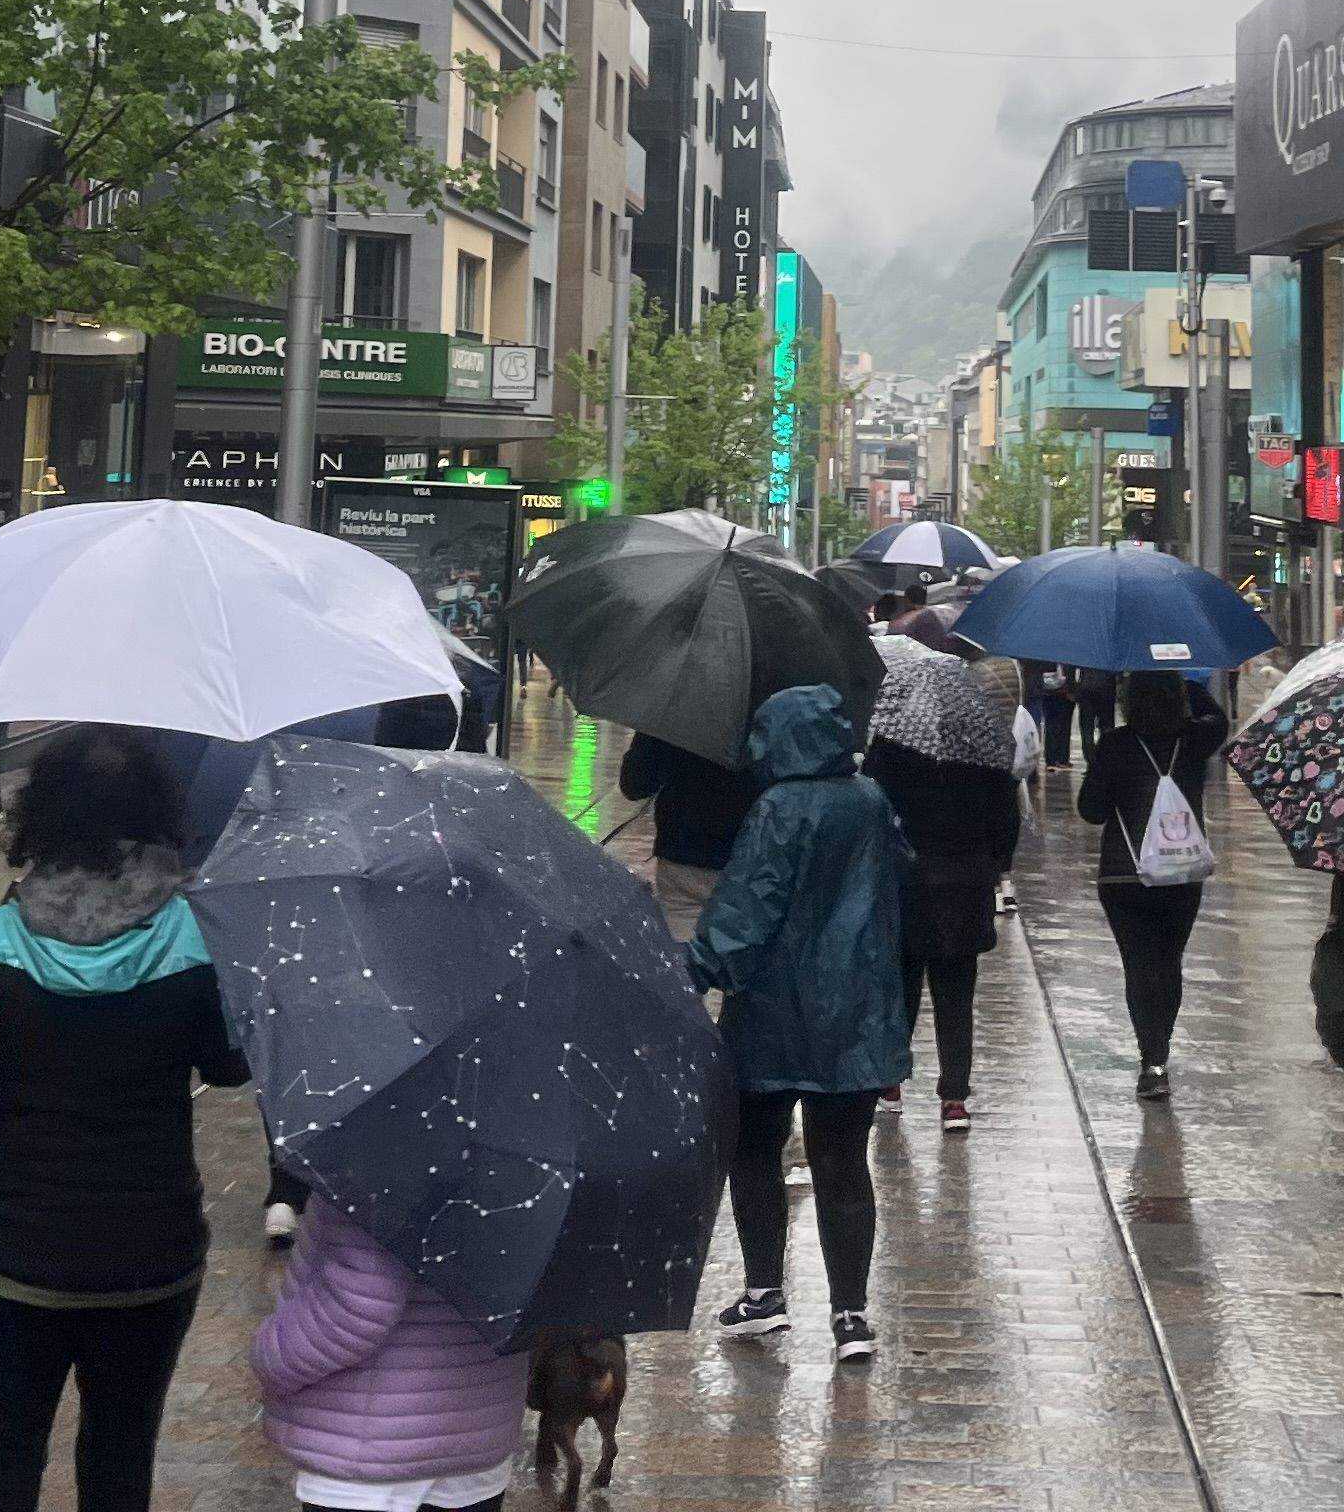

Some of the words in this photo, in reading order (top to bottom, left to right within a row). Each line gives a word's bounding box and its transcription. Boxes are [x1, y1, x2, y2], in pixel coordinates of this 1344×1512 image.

[732, 77, 759, 149] MIM
[733, 206, 752, 296] HOTE
[204, 332, 407, 364] BIO-CNTRE
[201, 363, 277, 377] LABORATORI
[343, 369, 403, 383] CLINIQUES
[1262, 438, 1290, 450] TAG
[401, 510, 436, 525] part
